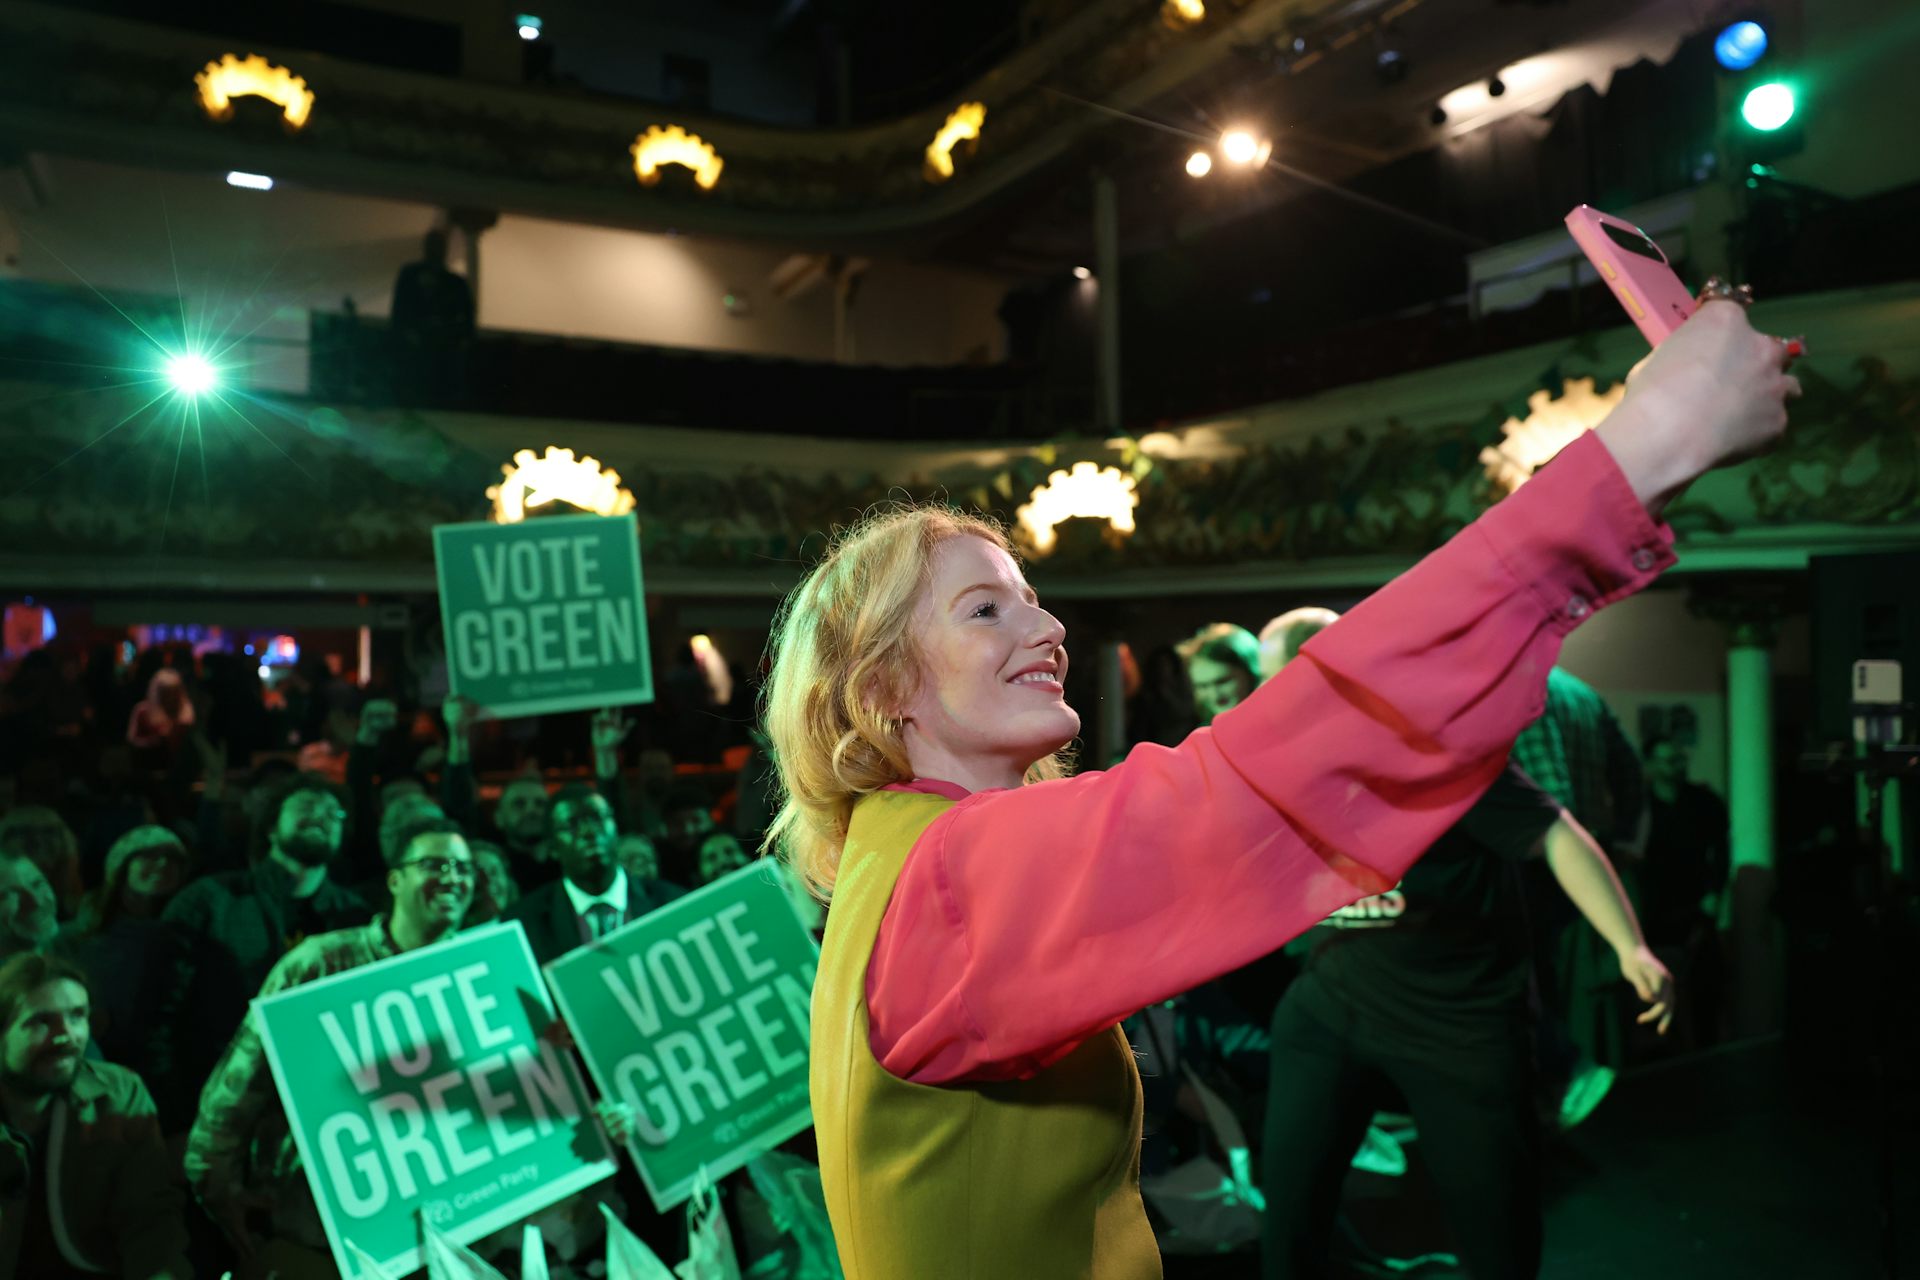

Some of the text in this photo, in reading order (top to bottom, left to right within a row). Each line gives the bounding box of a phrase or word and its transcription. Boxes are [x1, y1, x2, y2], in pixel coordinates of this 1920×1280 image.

[472, 535, 604, 605] VOTE
[454, 596, 637, 680] GREEN
[600, 901, 778, 1038] VOTE
[317, 961, 515, 1095] VOTE
[318, 1036, 582, 1220] GREEN
[453, 1162, 539, 1210] Green Party
